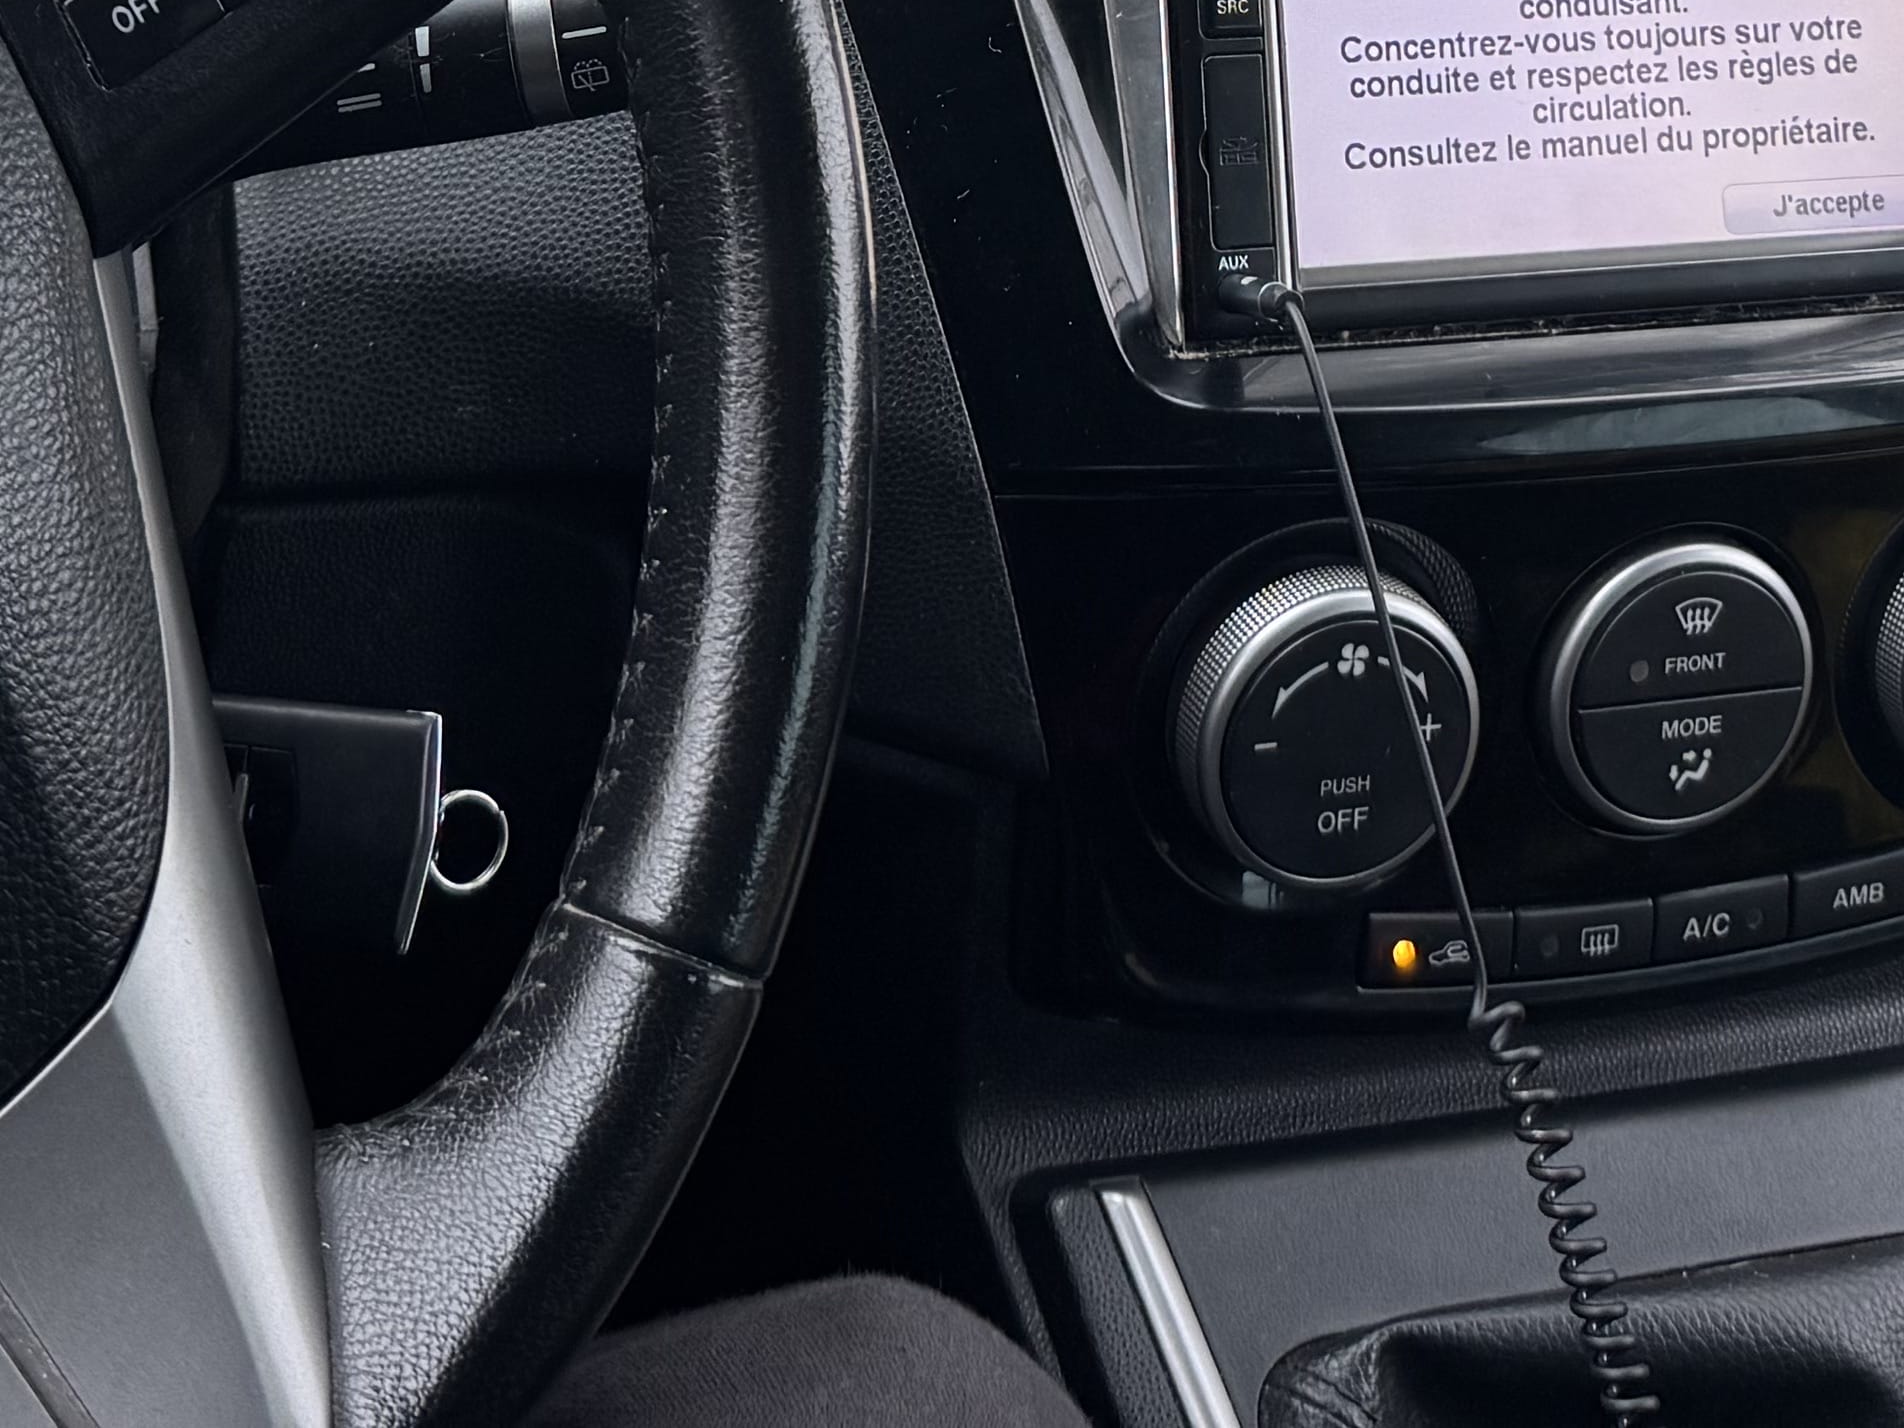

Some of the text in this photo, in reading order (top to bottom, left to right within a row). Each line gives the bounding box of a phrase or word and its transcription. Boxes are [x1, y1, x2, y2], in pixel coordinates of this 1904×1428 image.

[1216, 0, 1249, 15] SRC
[1340, 15, 1863, 63] Concentrez-vous toujours sur votre
[1350, 48, 1858, 99] conduite et respectez les règles de
[1532, 91, 1692, 125] circulation.
[1344, 114, 1876, 170] Consultez le manuel du propriétaire.
[1772, 190, 1886, 218] J'accepte
[1218, 255, 1249, 271] AUX
[1663, 651, 1726, 674] FRONT
[1660, 713, 1723, 741] MODE
[1319, 773, 1372, 798] PUSH
[1316, 805, 1370, 836] OFF
[1832, 882, 1885, 911] AMB
[1681, 909, 1731, 941] A/C
